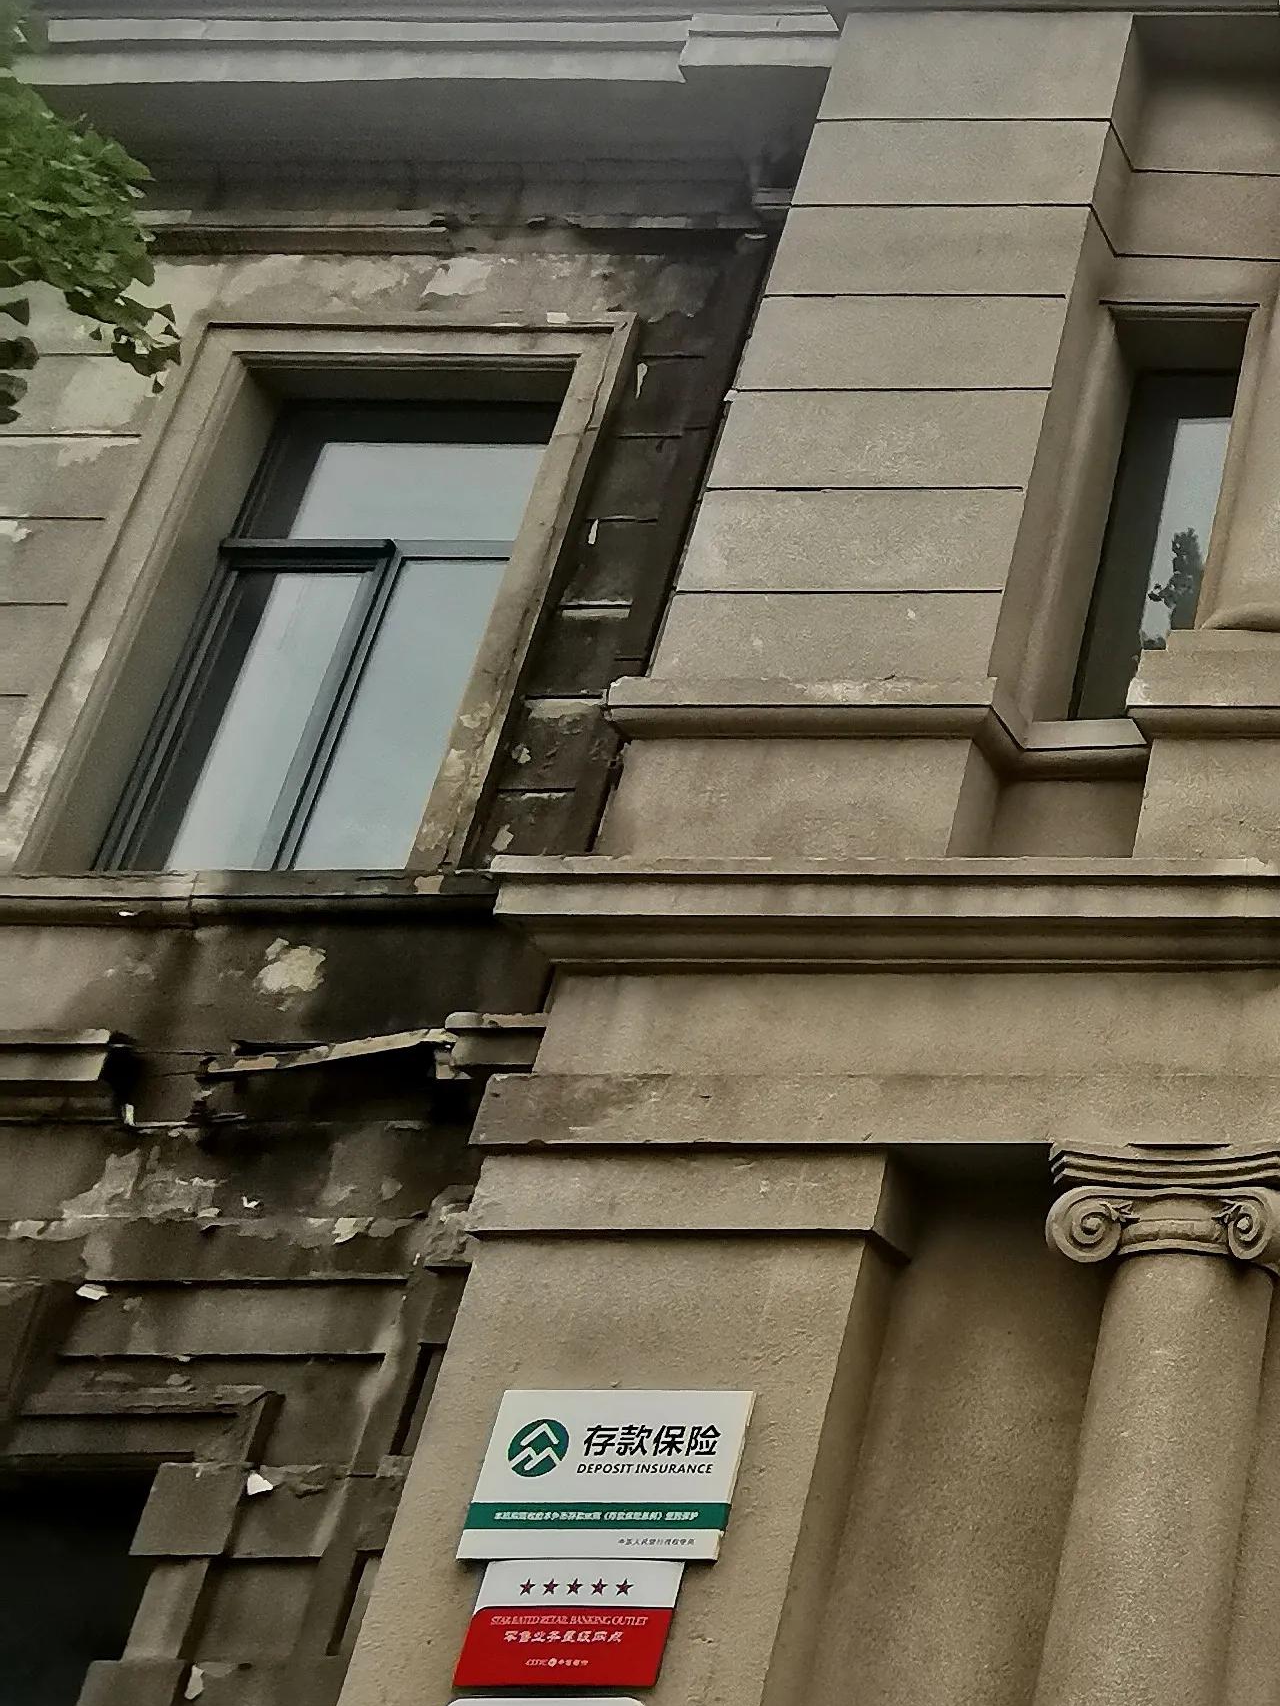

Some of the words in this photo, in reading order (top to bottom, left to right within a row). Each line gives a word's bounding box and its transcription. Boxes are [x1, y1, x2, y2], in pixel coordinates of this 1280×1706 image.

[583, 1424, 722, 1457] 存款保险
[577, 1463, 633, 1475] DEPOSIT
[635, 1463, 714, 1475] INSURANCE
